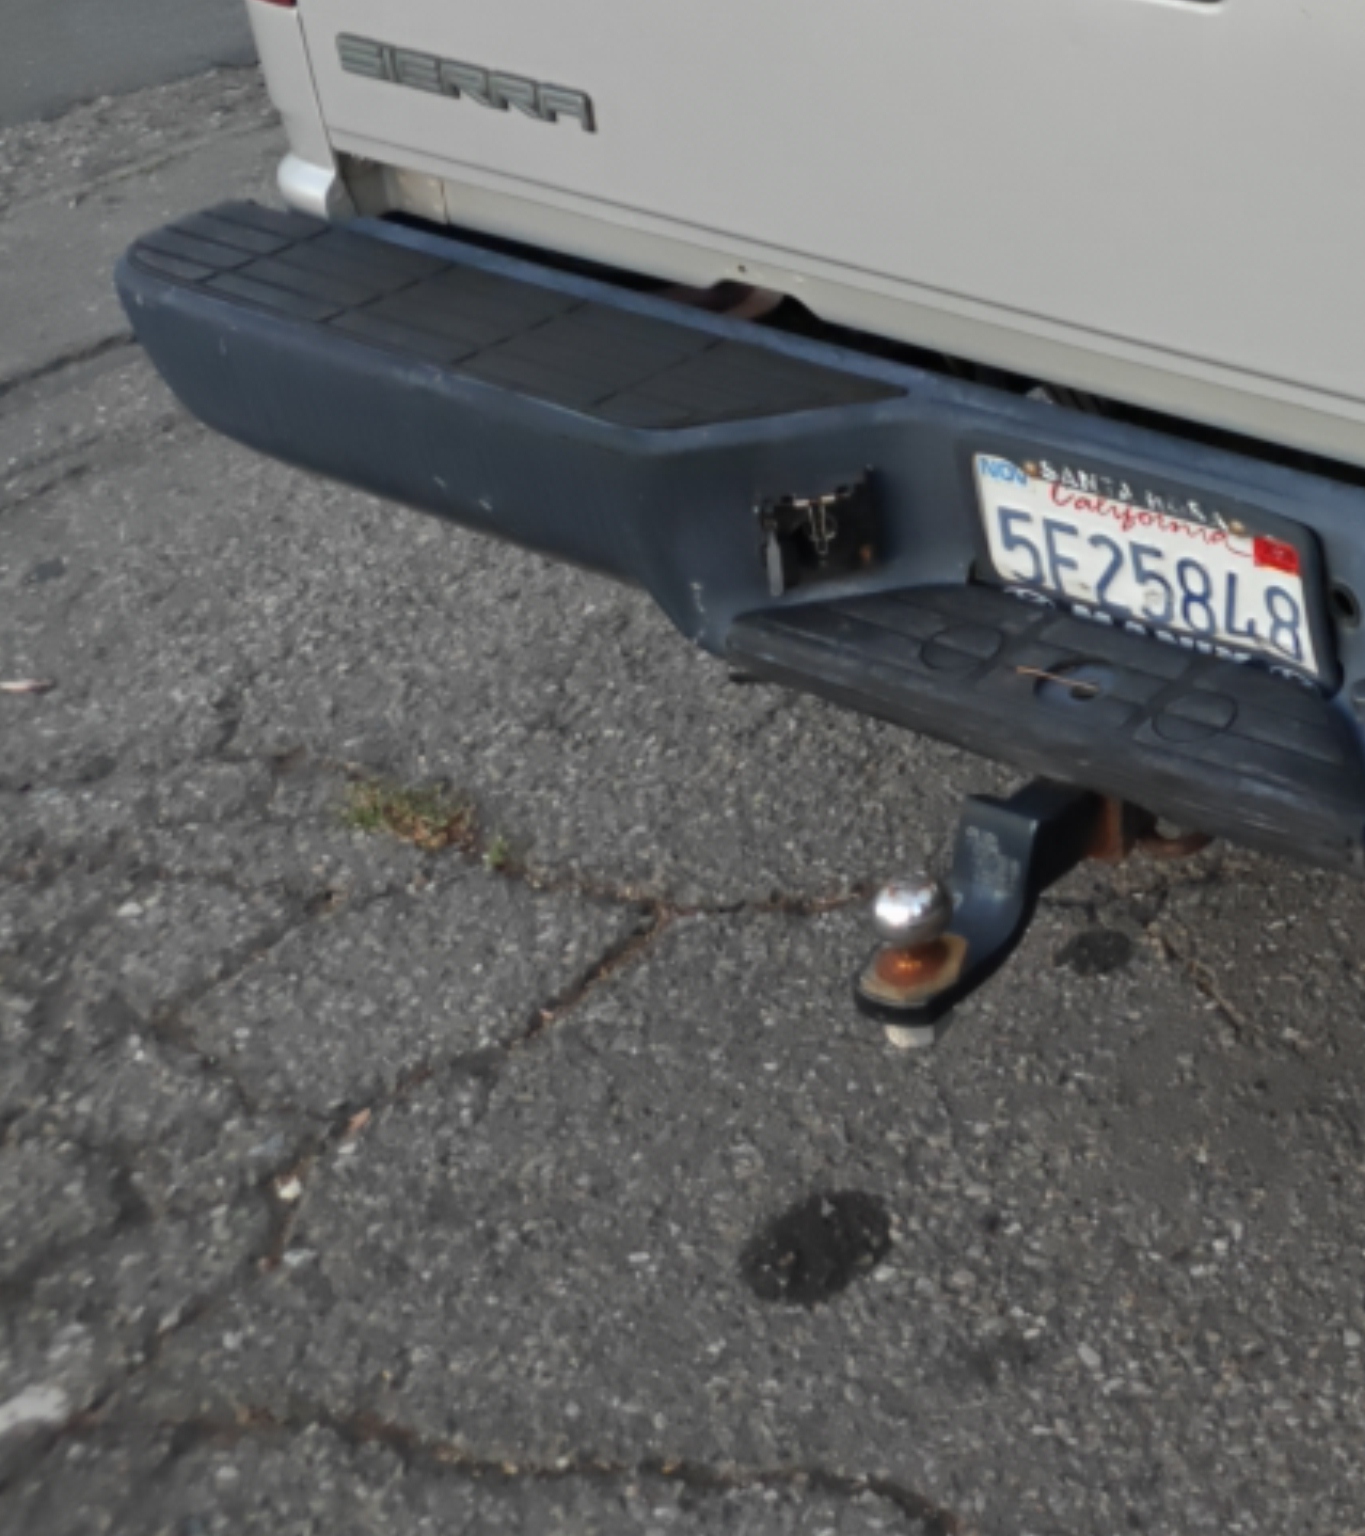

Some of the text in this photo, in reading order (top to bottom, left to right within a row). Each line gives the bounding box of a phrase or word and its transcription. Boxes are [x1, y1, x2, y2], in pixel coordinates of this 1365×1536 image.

[976, 456, 1029, 487] NOV
[1047, 481, 1250, 556] California
[995, 503, 1304, 662] 5F25848
